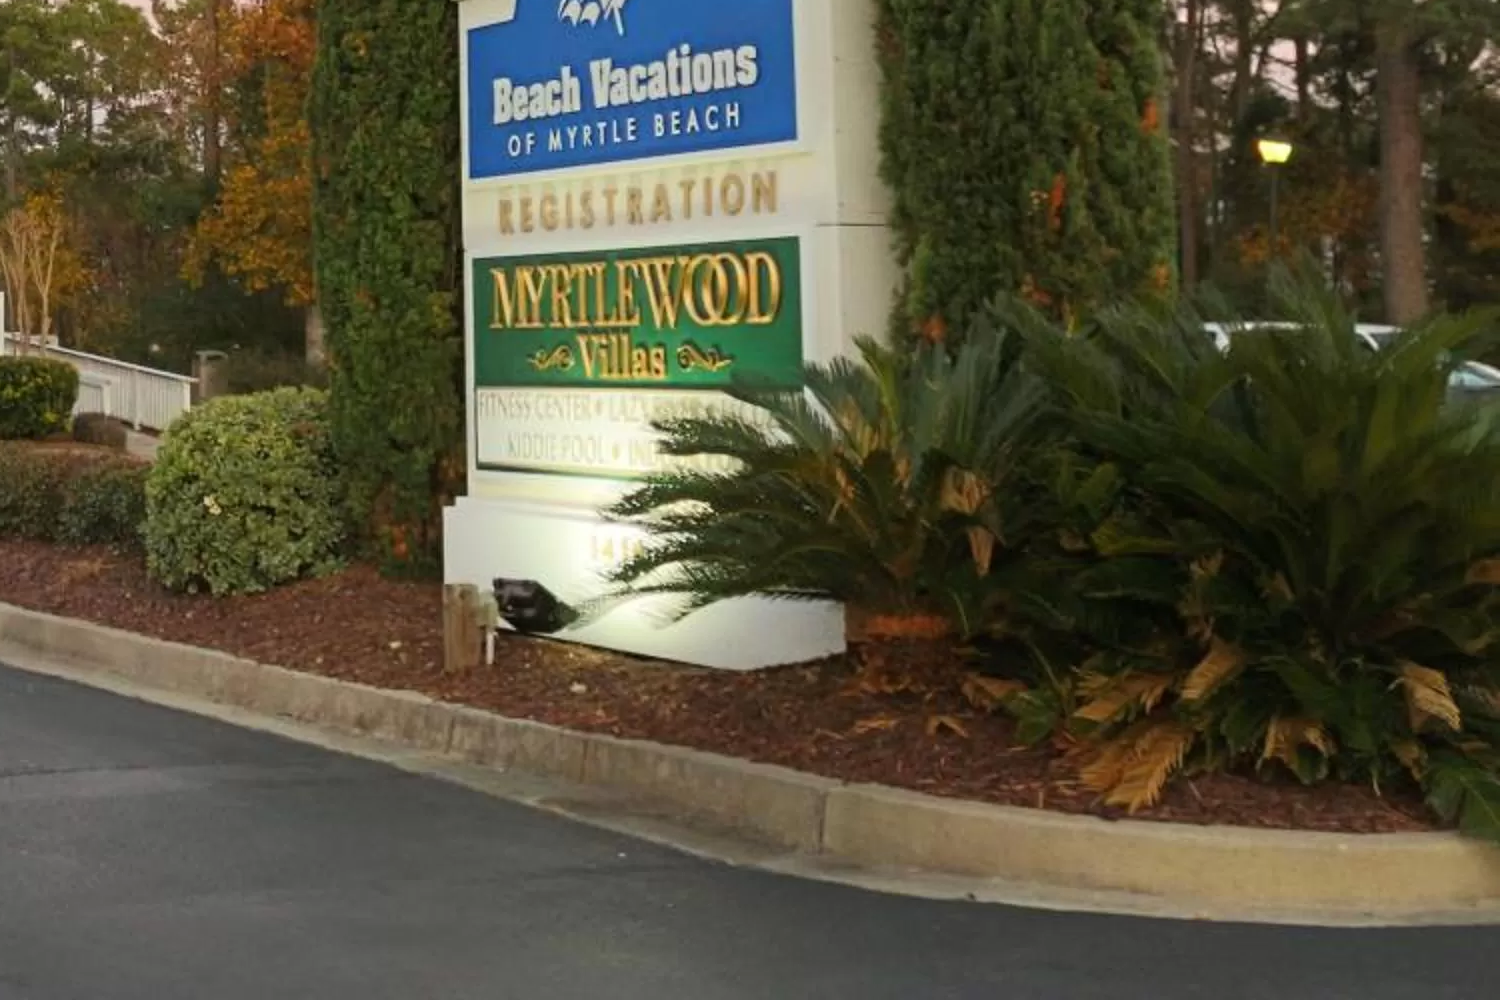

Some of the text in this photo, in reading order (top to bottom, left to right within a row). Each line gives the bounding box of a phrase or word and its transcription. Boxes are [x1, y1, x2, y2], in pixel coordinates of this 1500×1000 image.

[493, 43, 759, 126] Beach Vacations
[507, 102, 741, 157] OF MYRTLE BEACH
[498, 170, 780, 235] REGISTRATION
[488, 252, 782, 331] MYRTLEWOOD
[575, 332, 668, 380] Villas
[479, 391, 532, 421] FITNESS
[533, 392, 593, 423] CENTER
[506, 431, 558, 462] KIDDIE
[561, 433, 606, 464] POOL
